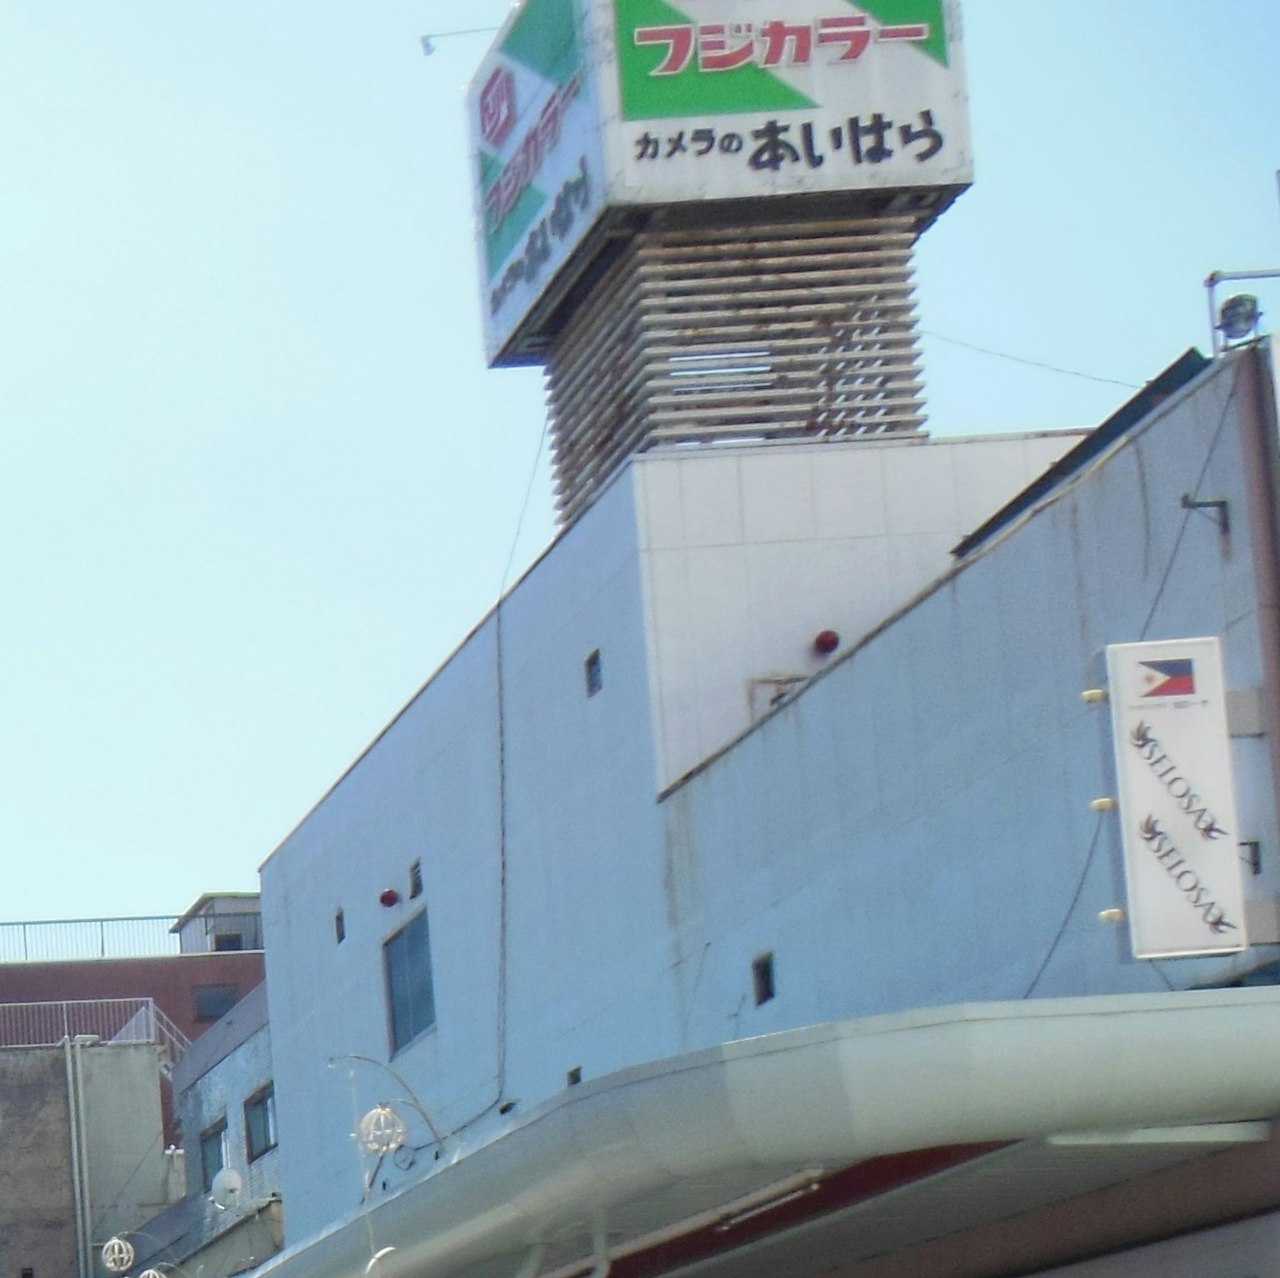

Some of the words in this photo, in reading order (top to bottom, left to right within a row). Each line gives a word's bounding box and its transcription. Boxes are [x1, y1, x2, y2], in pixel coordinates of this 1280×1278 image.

[634, 16, 928, 76] フジカラー
[634, 109, 943, 170] カメラのあいはら
